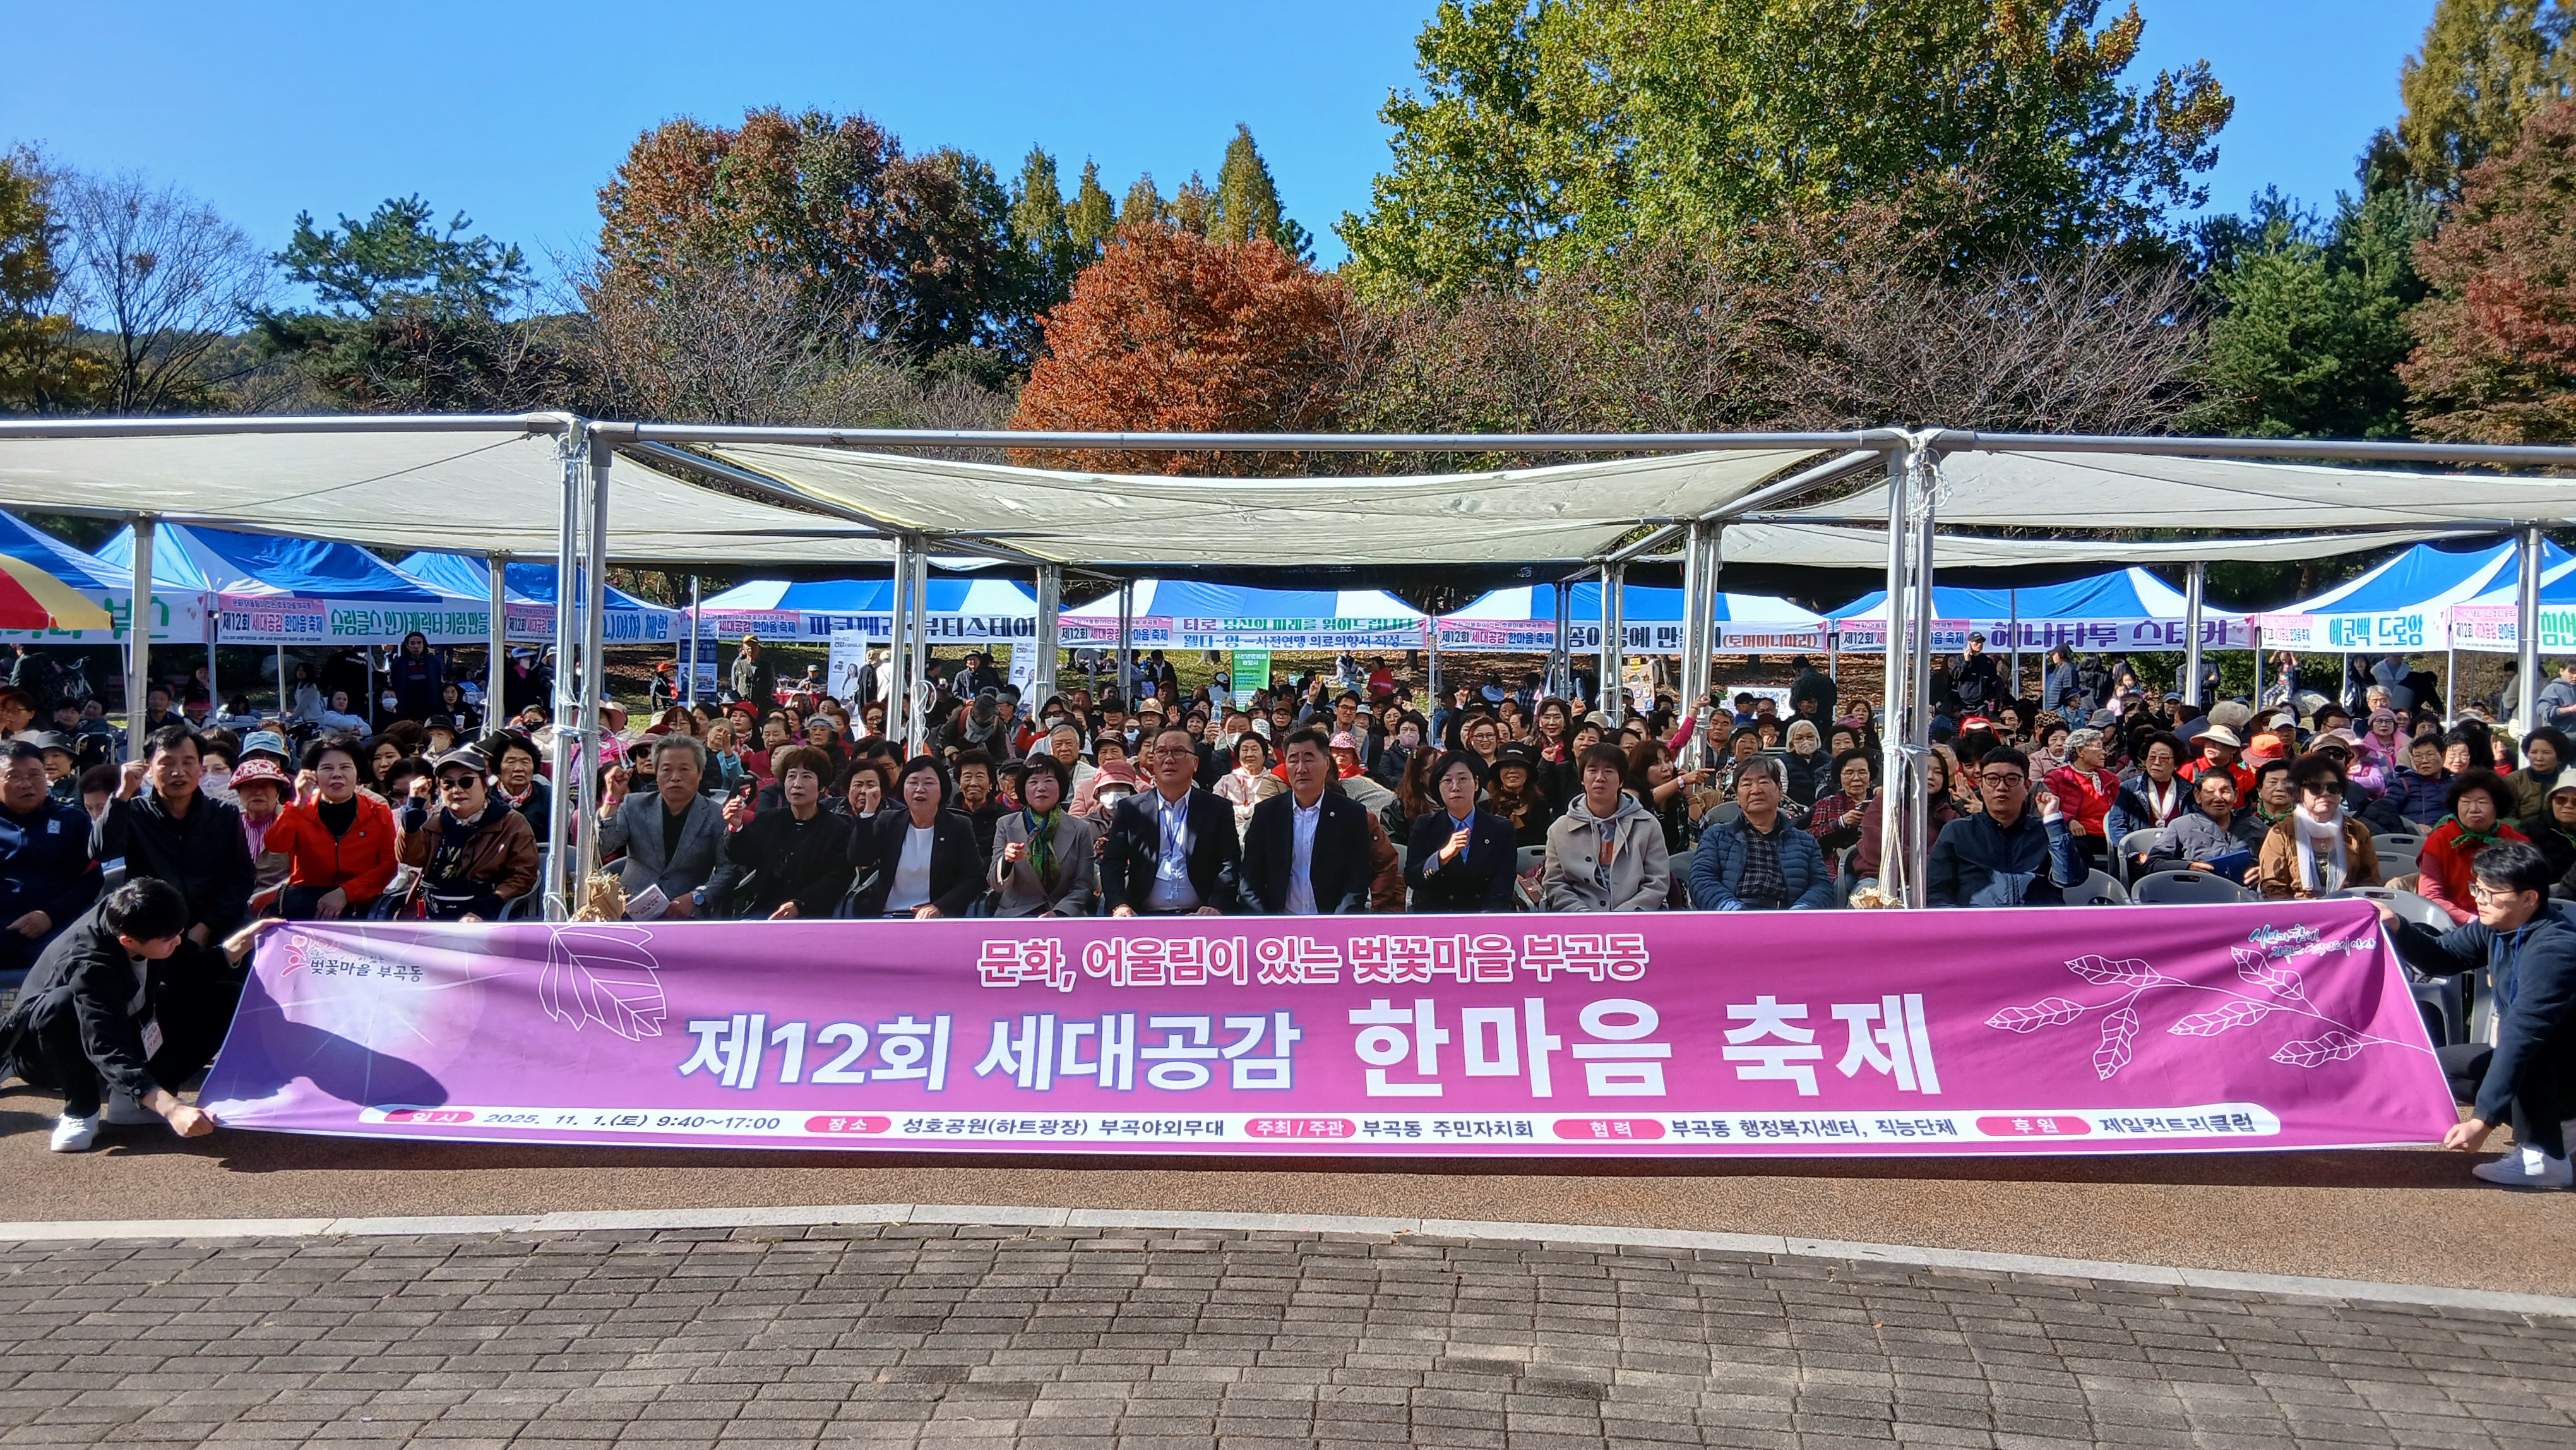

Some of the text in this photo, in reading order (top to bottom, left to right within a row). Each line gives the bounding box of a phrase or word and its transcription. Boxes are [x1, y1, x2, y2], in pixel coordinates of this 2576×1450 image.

[223, 611, 323, 633] 제12회 세대공감 한마음 축제
[331, 608, 382, 635] 슈링클스
[468, 611, 491, 635] 만들
[719, 621, 751, 633] 세대공감
[753, 621, 777, 633] 한마음
[779, 621, 796, 633] 축제
[1183, 618, 1413, 630] 타로 당신의 미래를 읽어드립니다
[2329, 613, 2423, 647] 에코백 드로잉
[1061, 627, 1088, 640] 제12회
[1152, 628, 1169, 641] 축제
[1309, 635, 1371, 648] 의료의향서
[1441, 630, 1554, 645] 제12회 세대공감 한마음 축제
[1844, 632, 1873, 645] 제12회
[1946, 632, 1964, 645] 축제
[310, 959, 424, 983] 벚꽃마을 부곡동
[977, 933, 1650, 993] 문화, 어울림이 있는 벚꽃마을 부곡동
[677, 993, 1942, 1098] 제12회 세대공감 한마음 축제
[482, 1114, 541, 1125] 2025.
[555, 1115, 578, 1126] 11.
[657, 1116, 780, 1130] 9:40~17:00
[902, 1118, 1088, 1136] 성호공원(하트광장)
[1099, 1119, 1225, 1136] 부곡야외무대
[1362, 1120, 1422, 1137] 부곡동
[1433, 1120, 1534, 1137] 주민자치회
[1671, 1120, 1731, 1137] 부곡동
[1739, 1120, 1868, 1137] 행정복지센터,
[1876, 1118, 1958, 1136] 직능단체
[2099, 1113, 2257, 1133] 제일컨트리클럽
